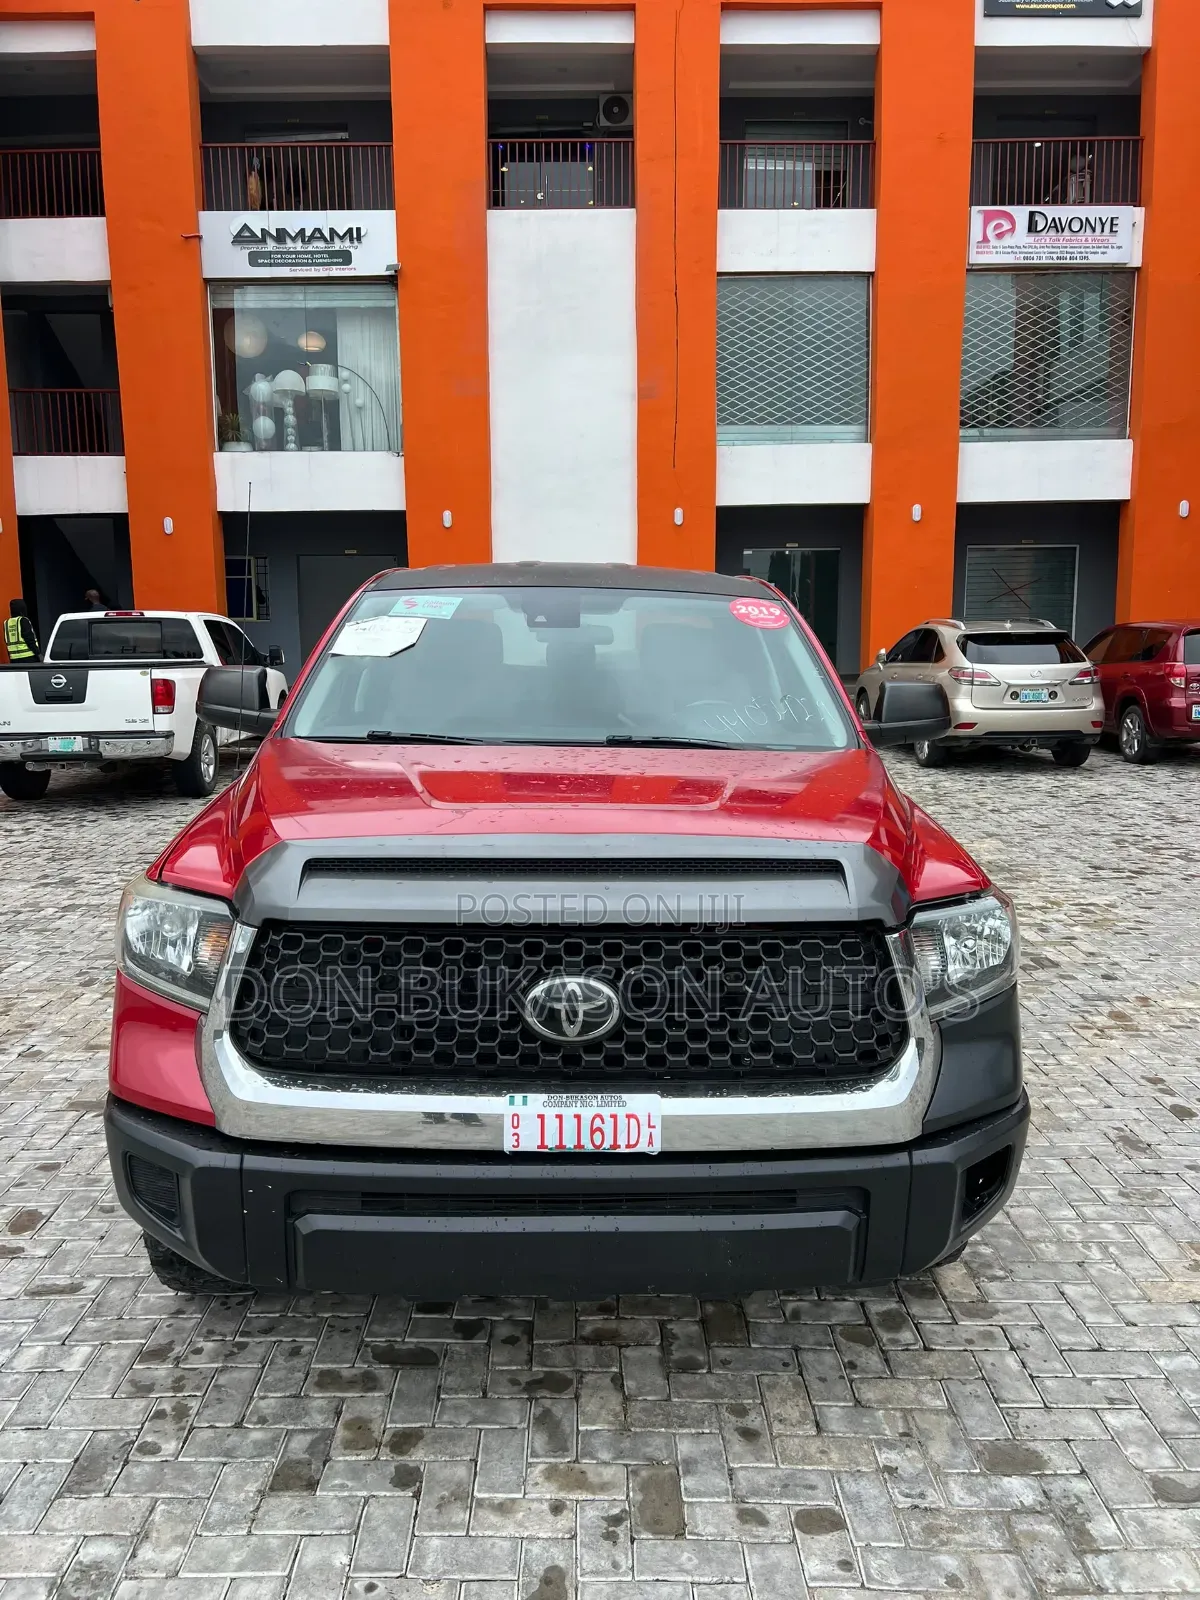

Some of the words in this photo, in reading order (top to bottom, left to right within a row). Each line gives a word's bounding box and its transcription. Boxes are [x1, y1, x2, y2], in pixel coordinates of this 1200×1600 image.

[231, 222, 362, 245] ANMAMI
[735, 604, 781, 616] 2019
[542, 1100, 579, 1108] COMPANY
[596, 1100, 627, 1108] LIMITED
[536, 1113, 641, 1150] 11161D
